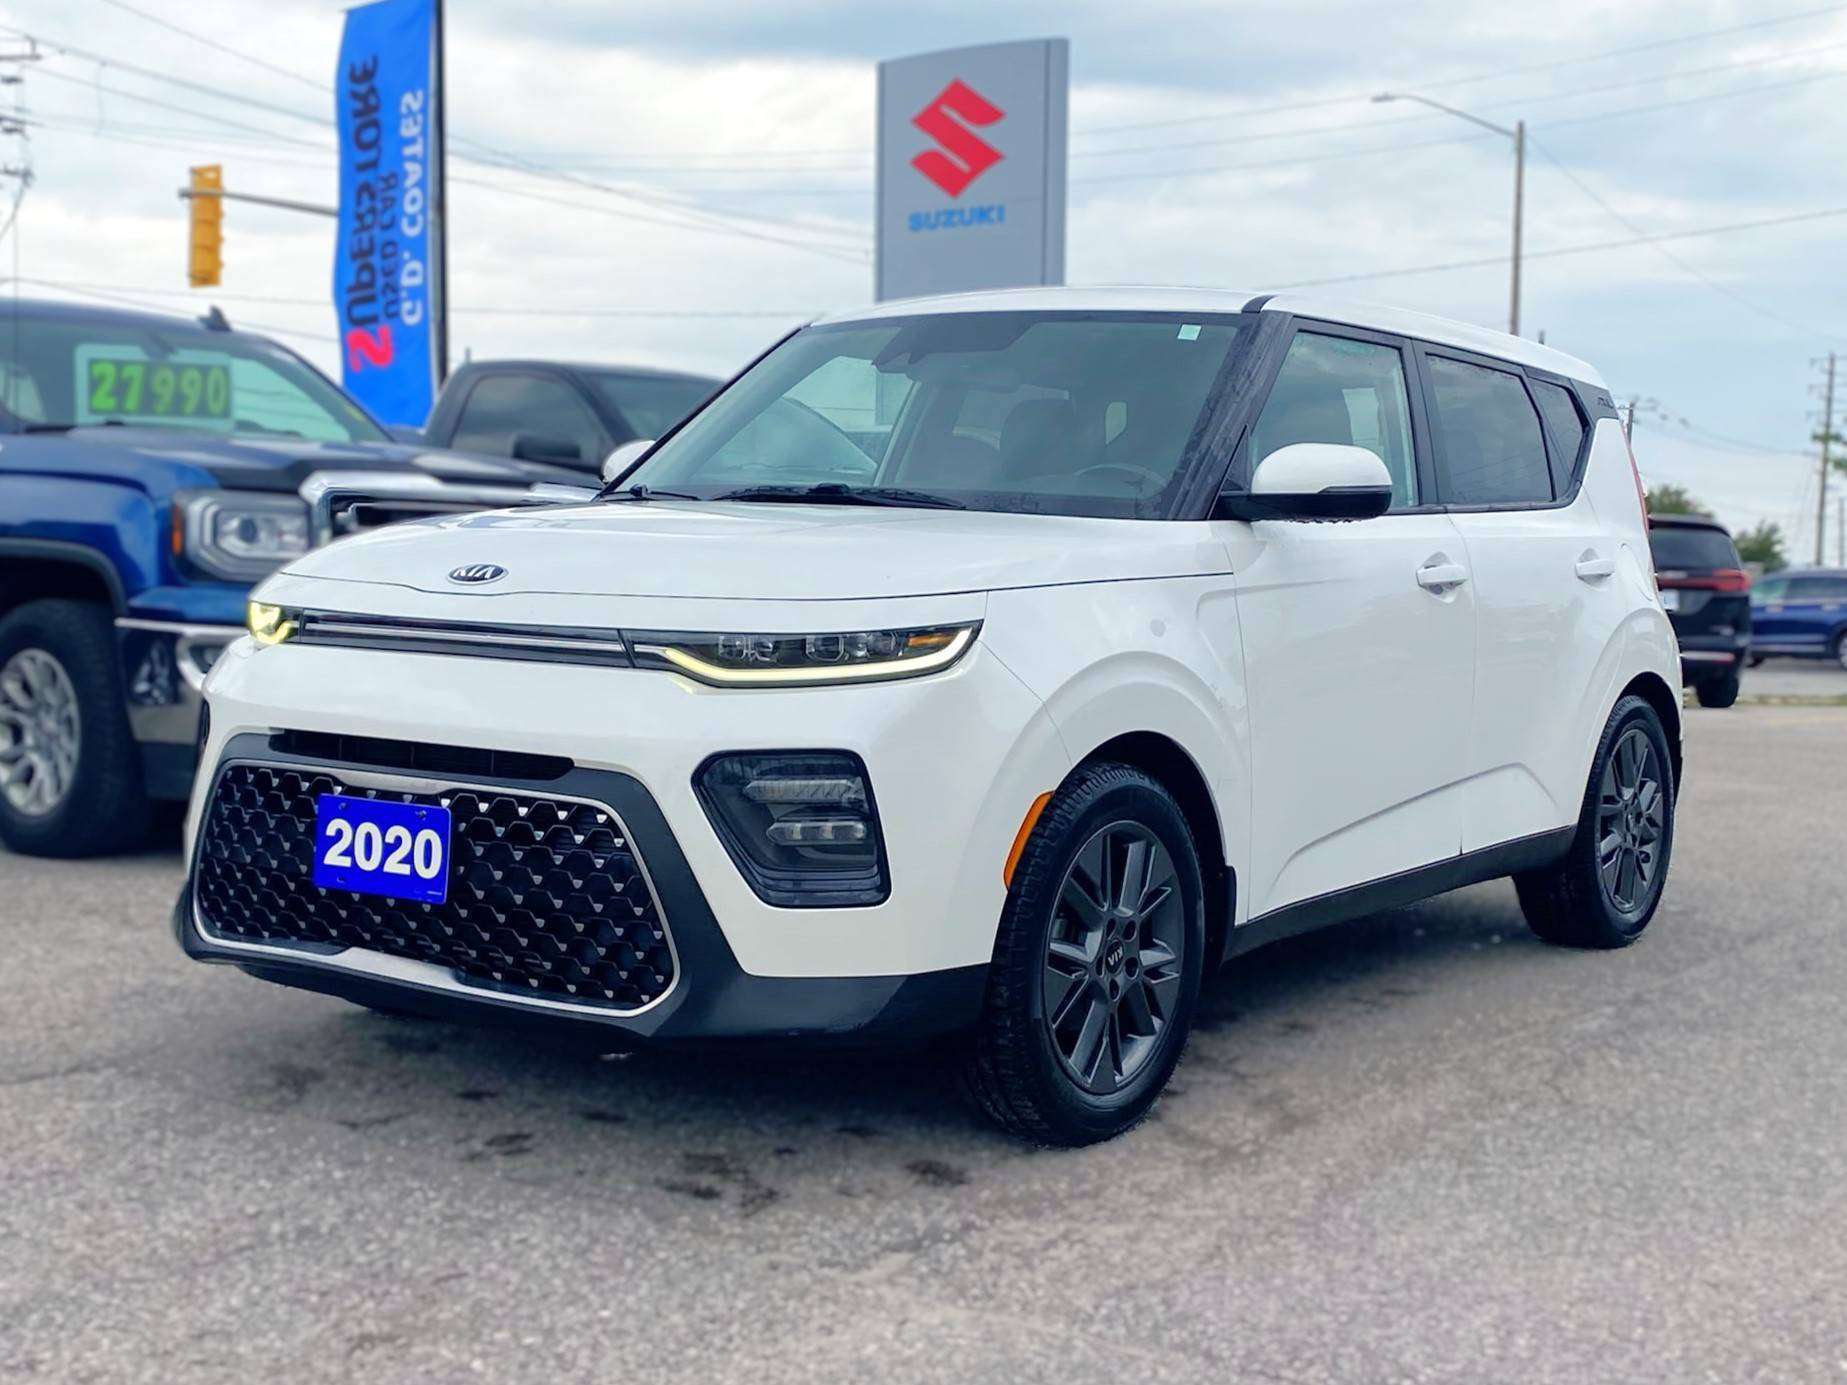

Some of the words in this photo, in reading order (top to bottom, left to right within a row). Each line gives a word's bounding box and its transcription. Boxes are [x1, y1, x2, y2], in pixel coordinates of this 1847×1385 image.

[908, 205, 1006, 231] SUZUKI
[91, 360, 227, 416] 27990
[323, 818, 443, 880] 2020
